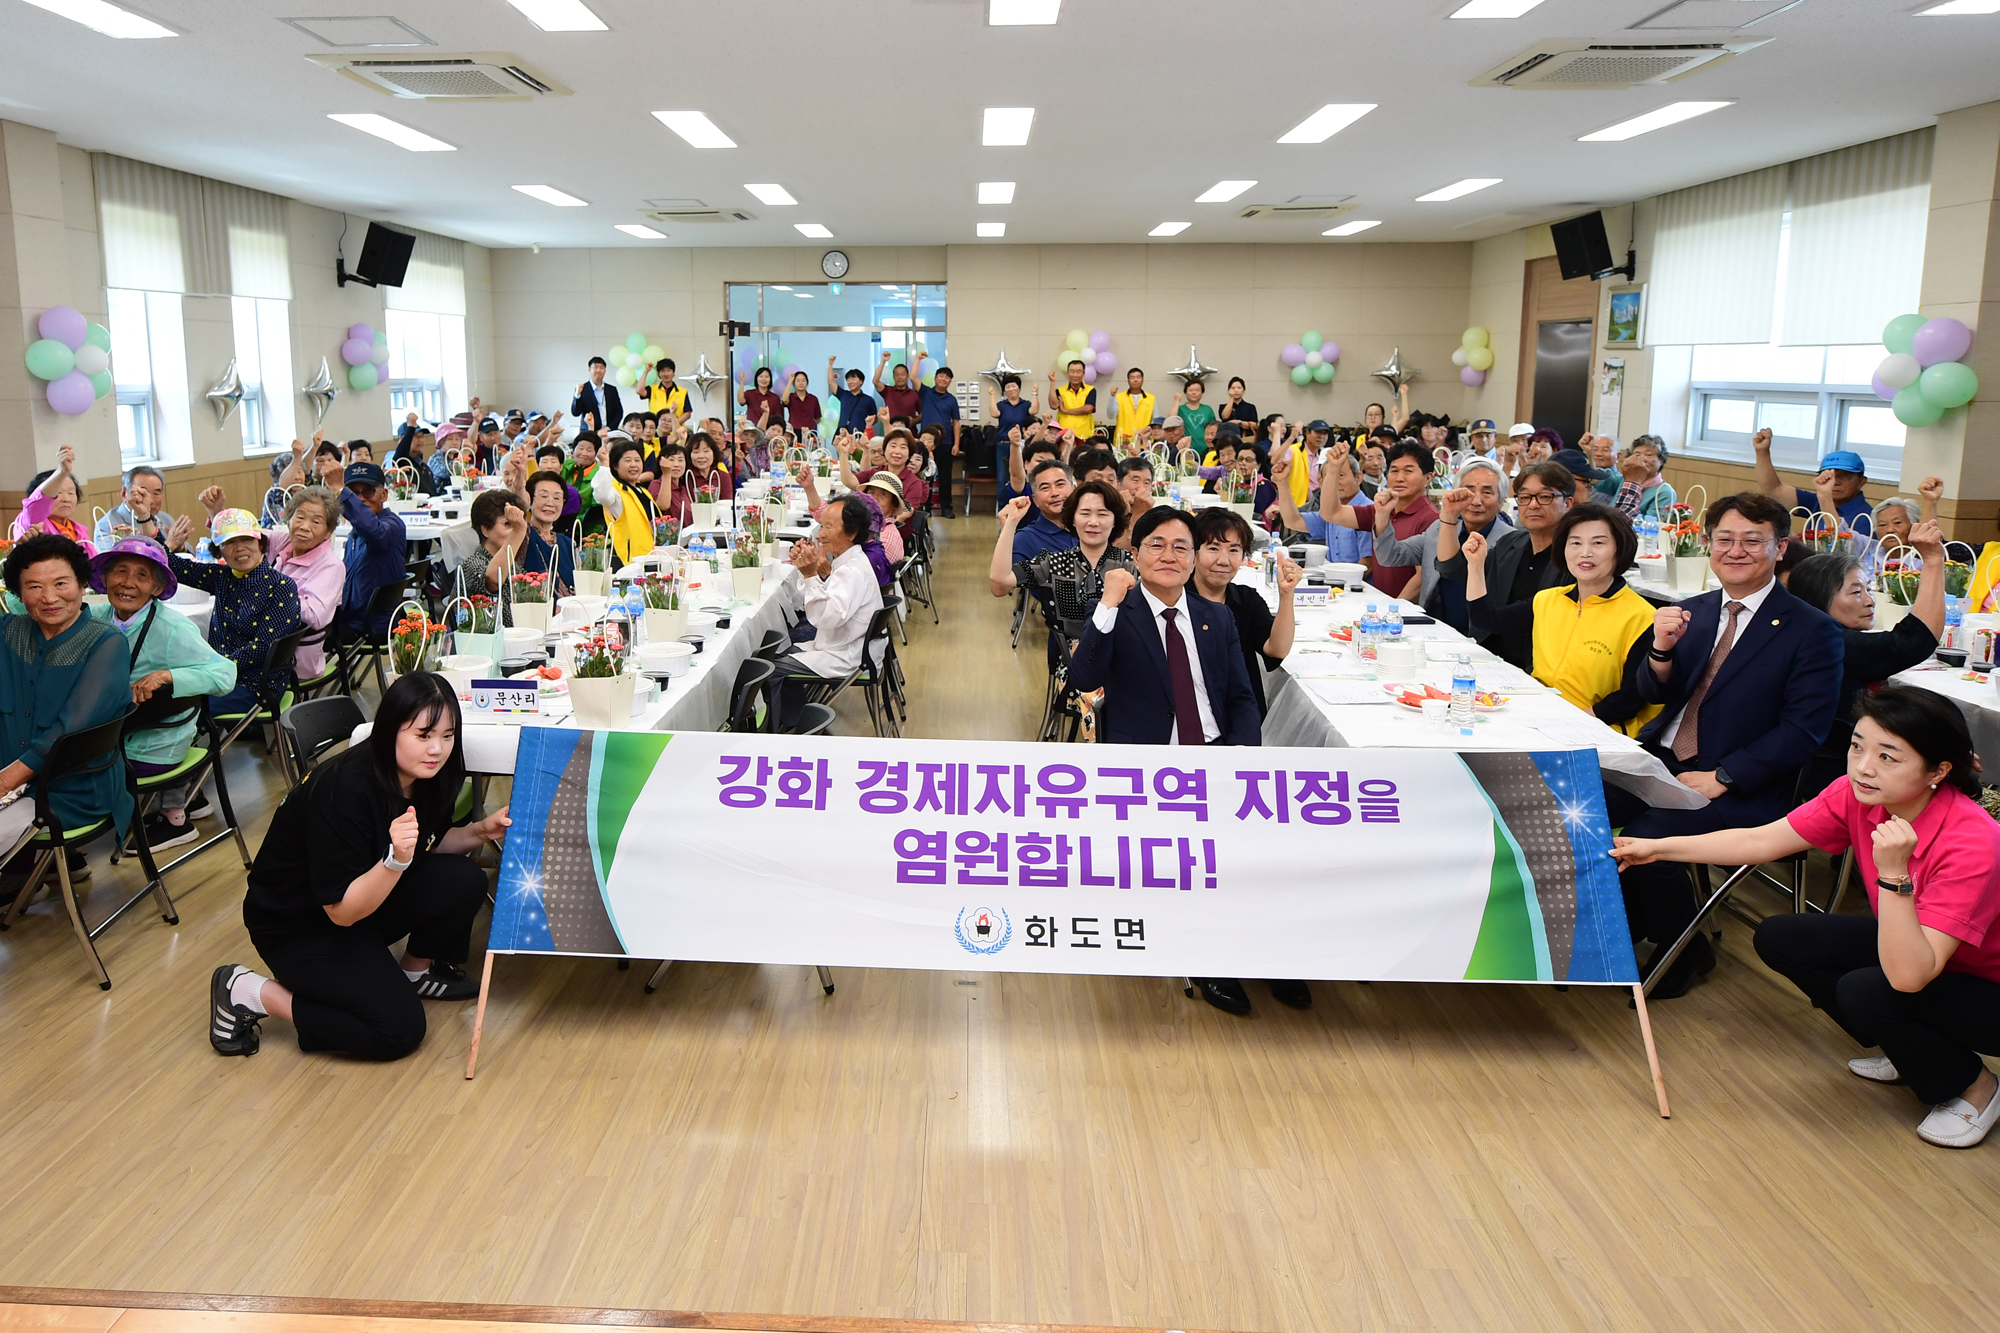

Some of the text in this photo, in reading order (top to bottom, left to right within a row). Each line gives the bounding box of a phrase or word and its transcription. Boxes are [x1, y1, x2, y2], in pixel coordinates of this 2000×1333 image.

[1296, 595, 1326, 604] 내빈석
[494, 691, 535, 707] 문산리
[717, 755, 1402, 827] 강화 경제자유구역 지정을
[893, 828, 1218, 892] 염원합니다!
[1024, 915, 1146, 950] 화도면
